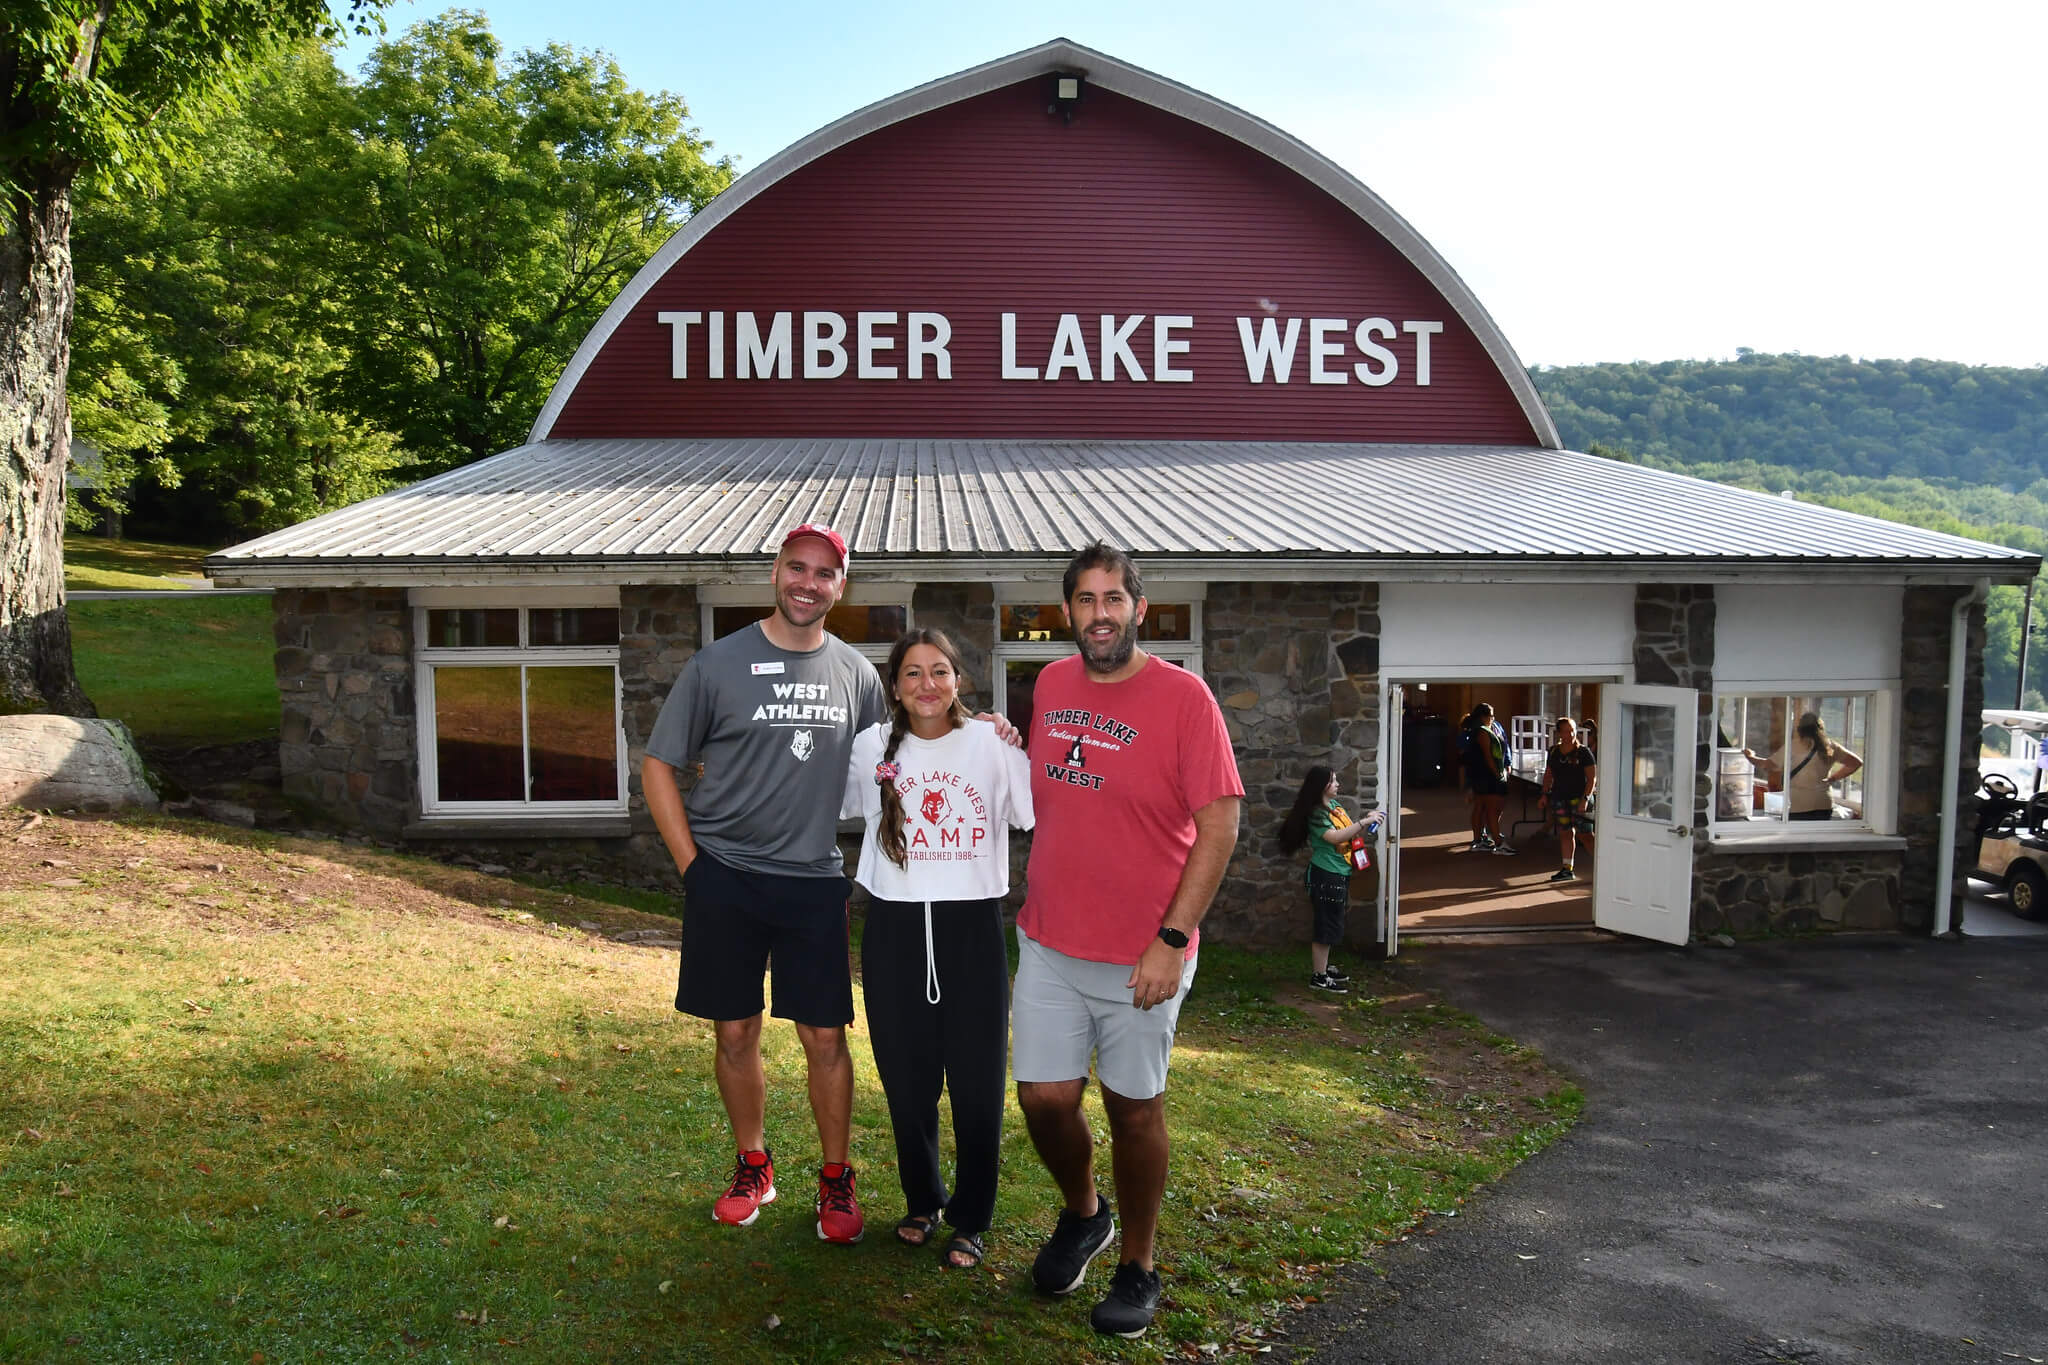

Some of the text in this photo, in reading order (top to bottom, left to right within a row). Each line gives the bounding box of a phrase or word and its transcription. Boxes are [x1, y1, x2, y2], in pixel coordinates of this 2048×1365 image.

[657, 311, 1444, 387] TIMBER LAKE WEST
[772, 683, 829, 700] WEST
[752, 704, 848, 723] ATHLETICS
[1044, 709, 1139, 745] TIMBER LAKE
[1048, 728, 1121, 751] Indian Summer
[1045, 763, 1105, 790] WEST
[896, 770, 987, 823] BER LAKE WEST
[911, 827, 986, 849] AMP
[909, 850, 973, 861] TABLISHED 1988
